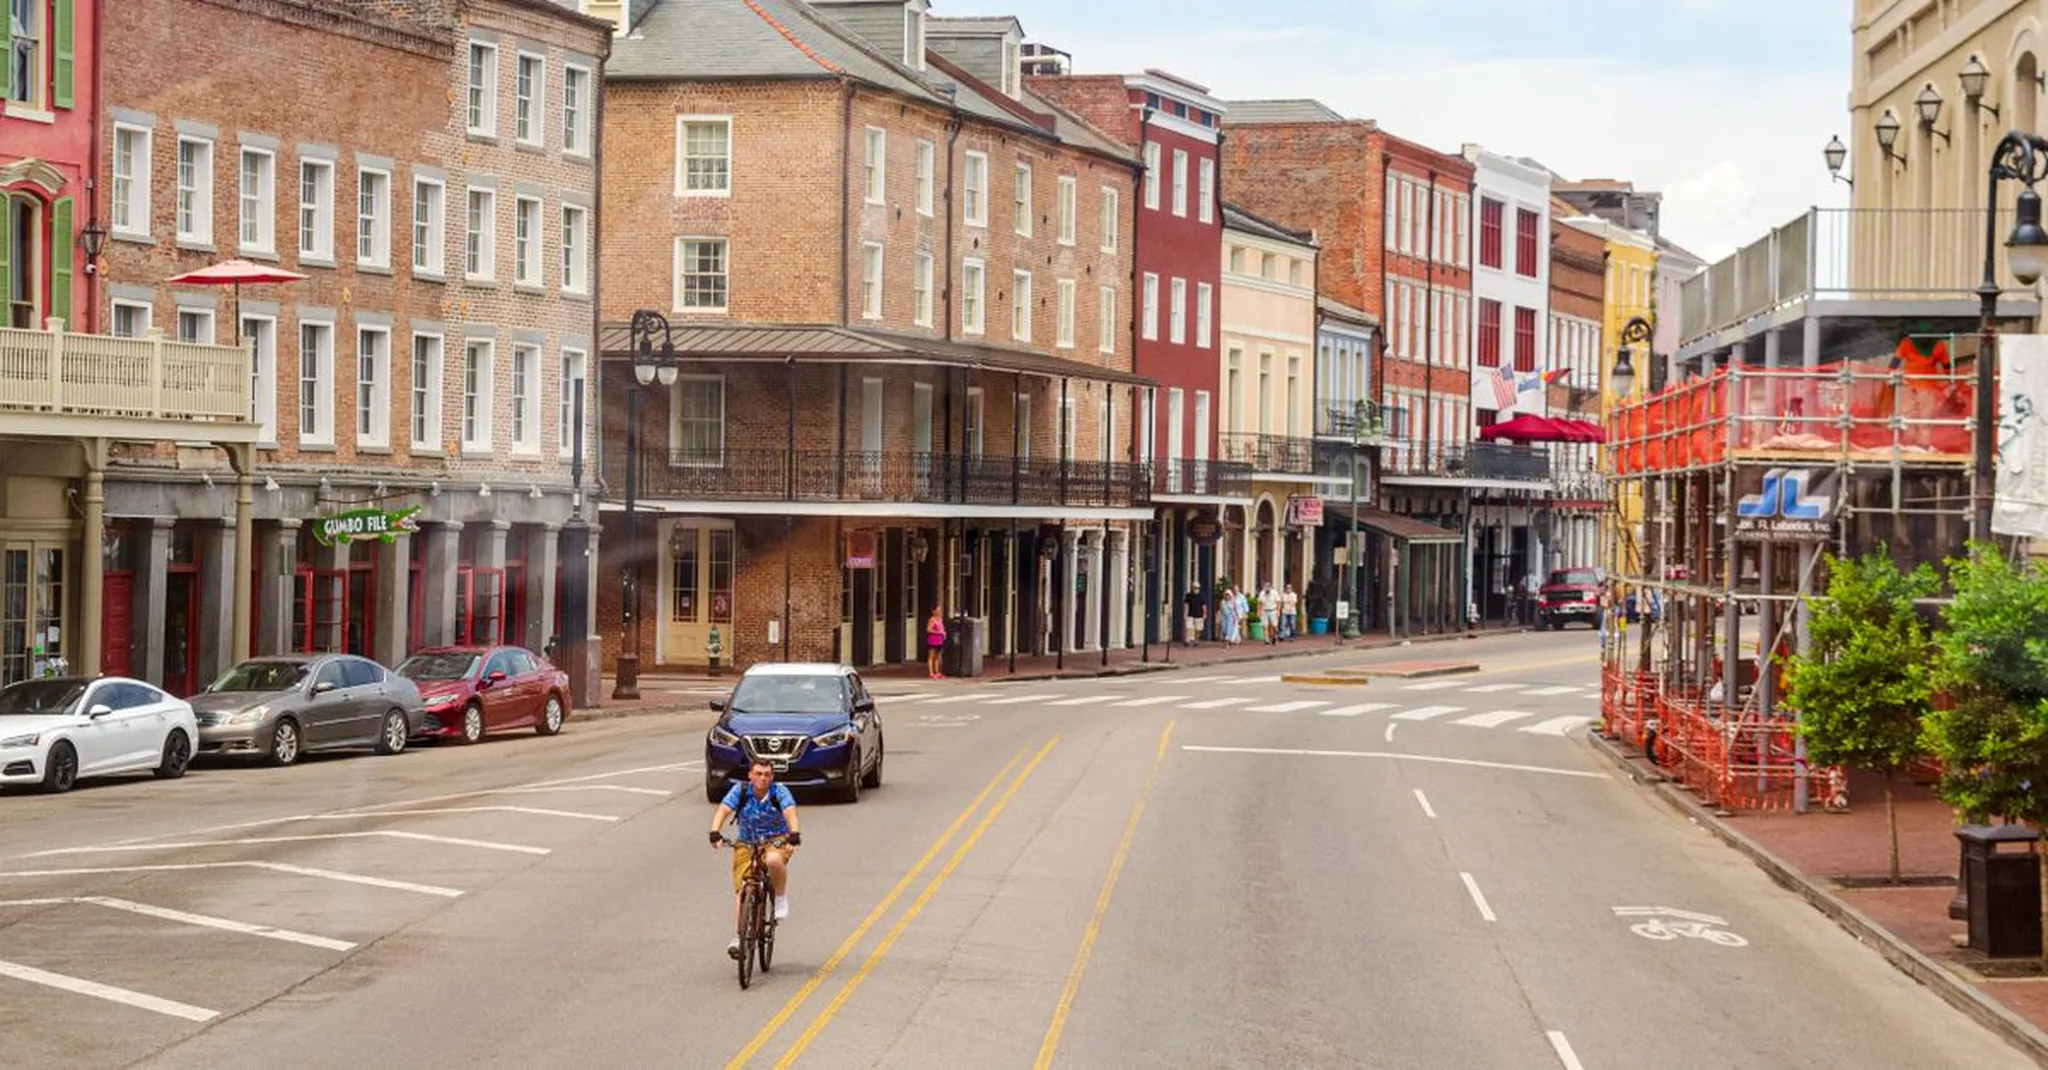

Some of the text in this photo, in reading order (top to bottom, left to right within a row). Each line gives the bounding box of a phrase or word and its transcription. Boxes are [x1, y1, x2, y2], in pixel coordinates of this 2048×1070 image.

[1737, 468, 1831, 519] JL
[323, 515, 388, 534] GUMBO FILE
